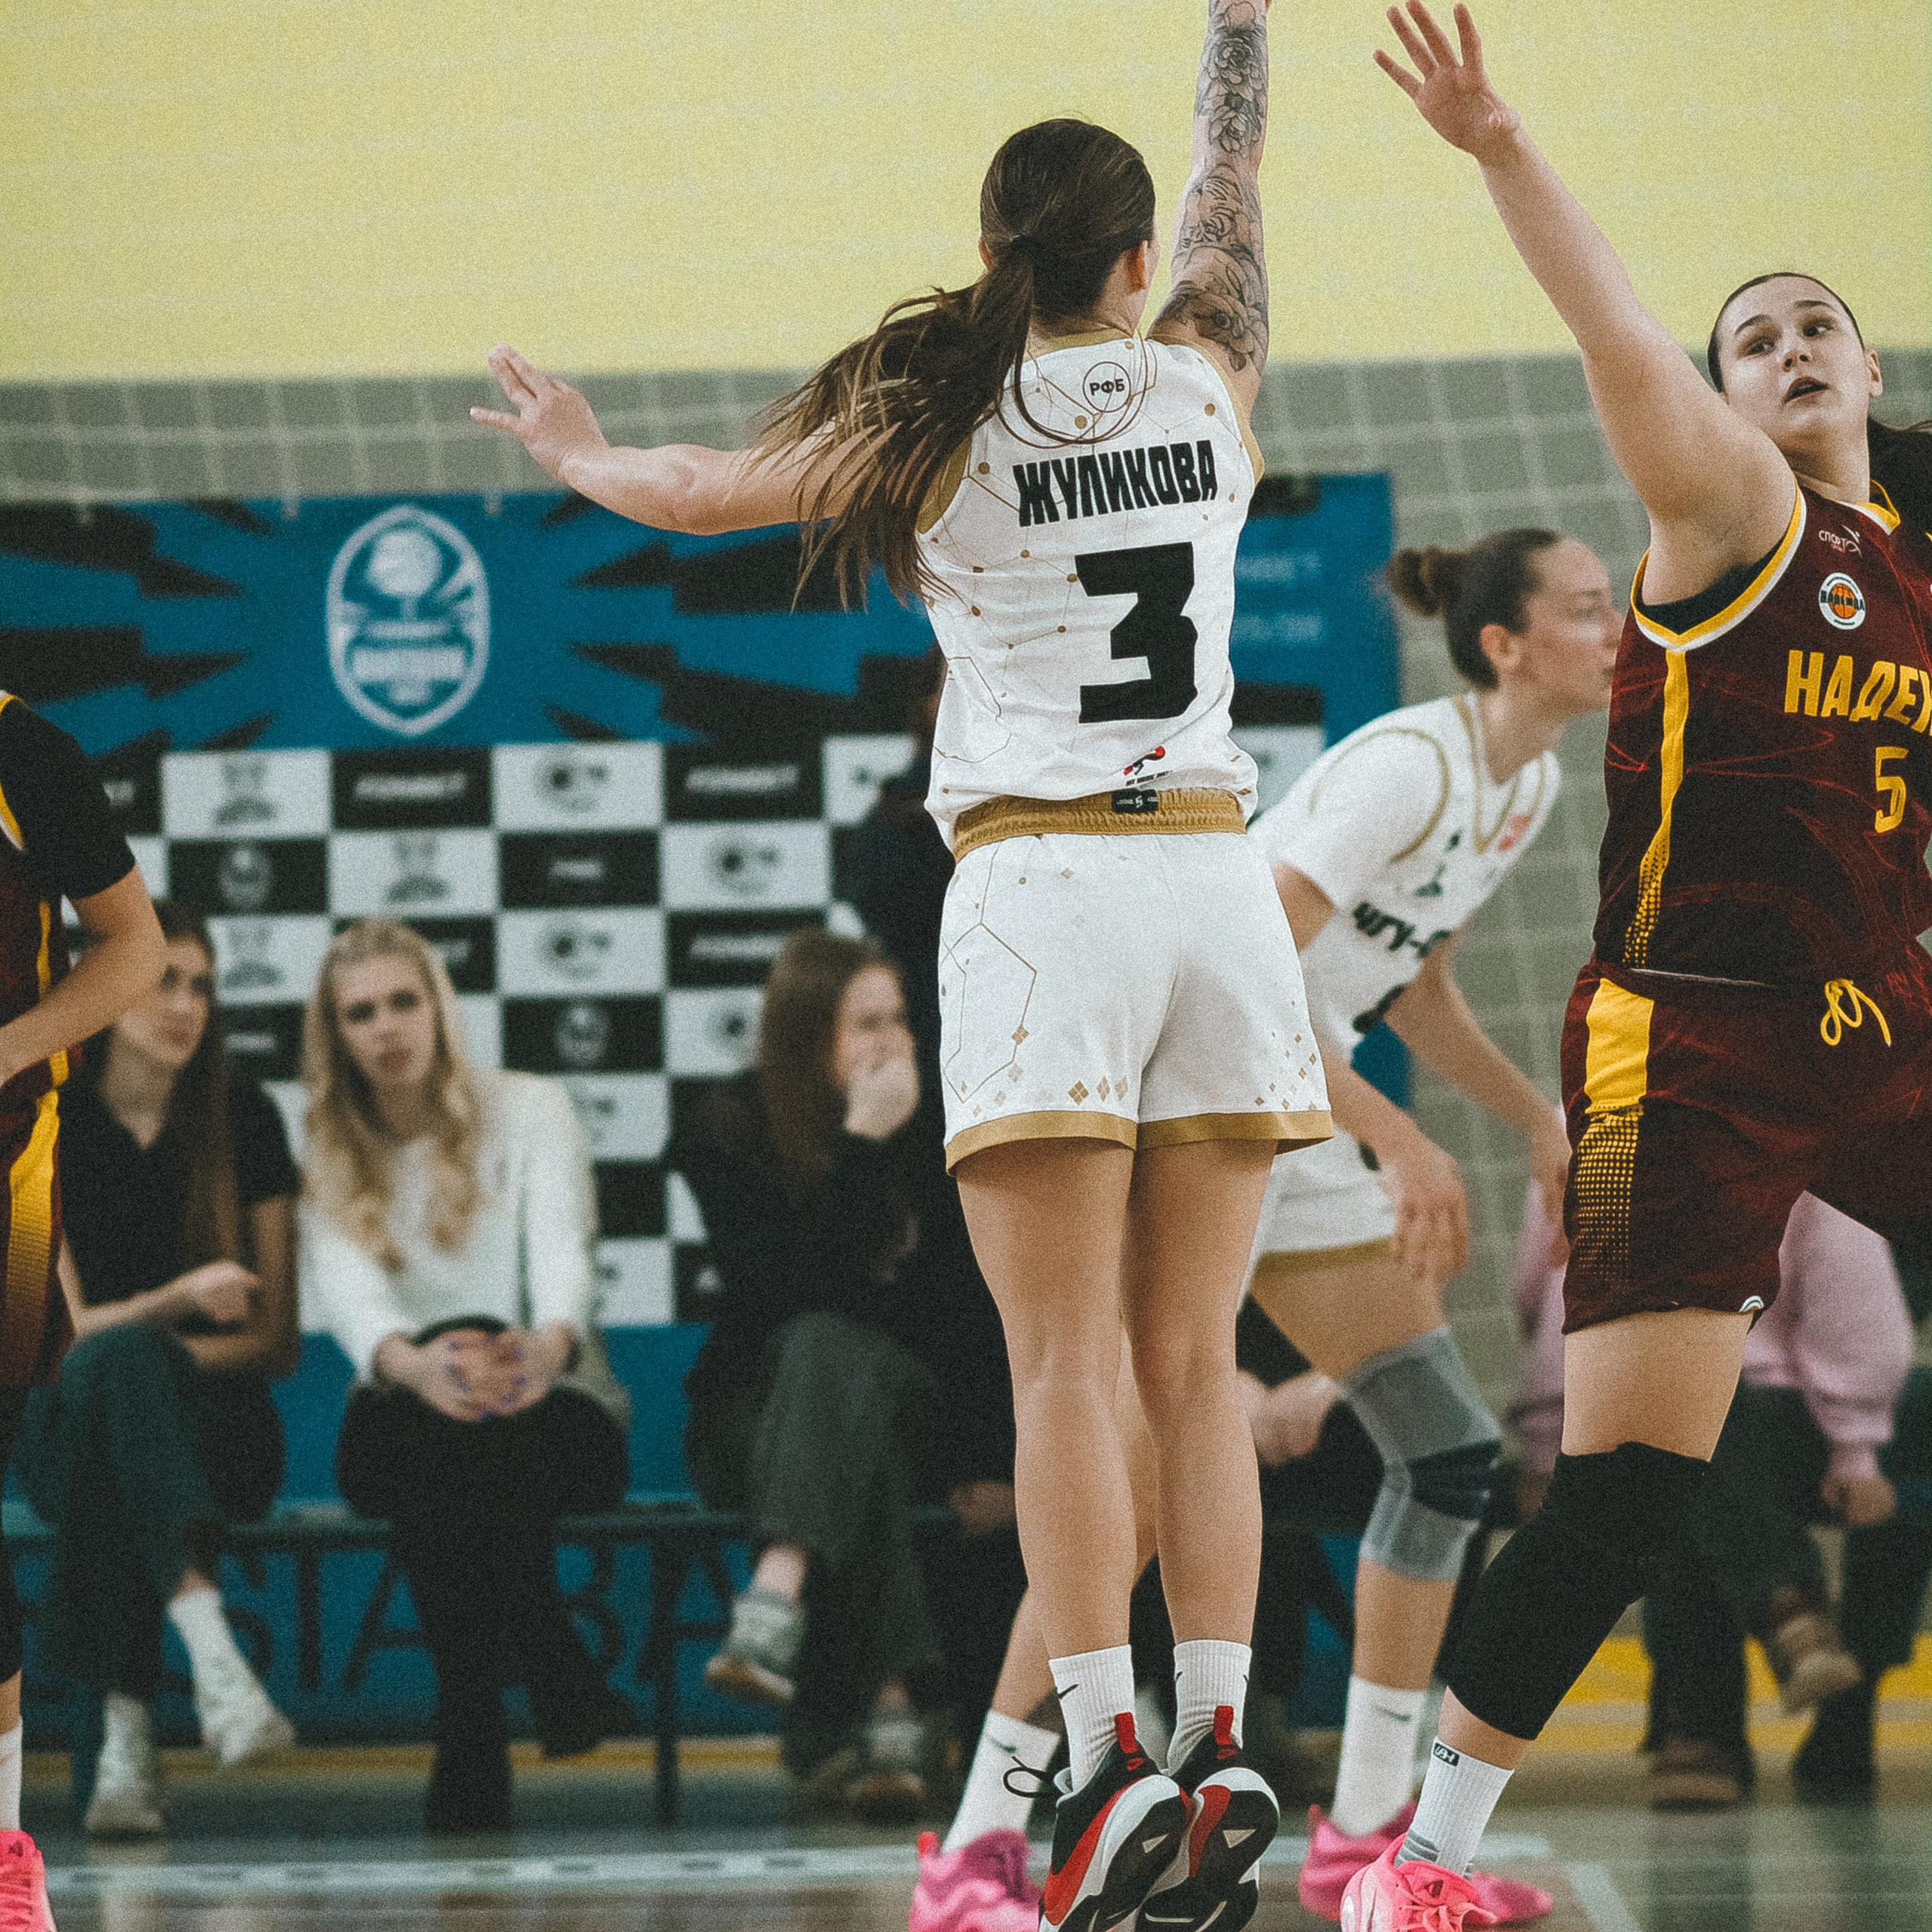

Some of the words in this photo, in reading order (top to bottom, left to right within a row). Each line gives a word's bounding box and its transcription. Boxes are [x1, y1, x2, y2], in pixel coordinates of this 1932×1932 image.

[1089, 378, 1125, 396] РФБ
[1012, 439, 1218, 528] ЖУЛИКОВА
[1074, 541, 1198, 724] 3
[1875, 746, 1909, 833] 5
